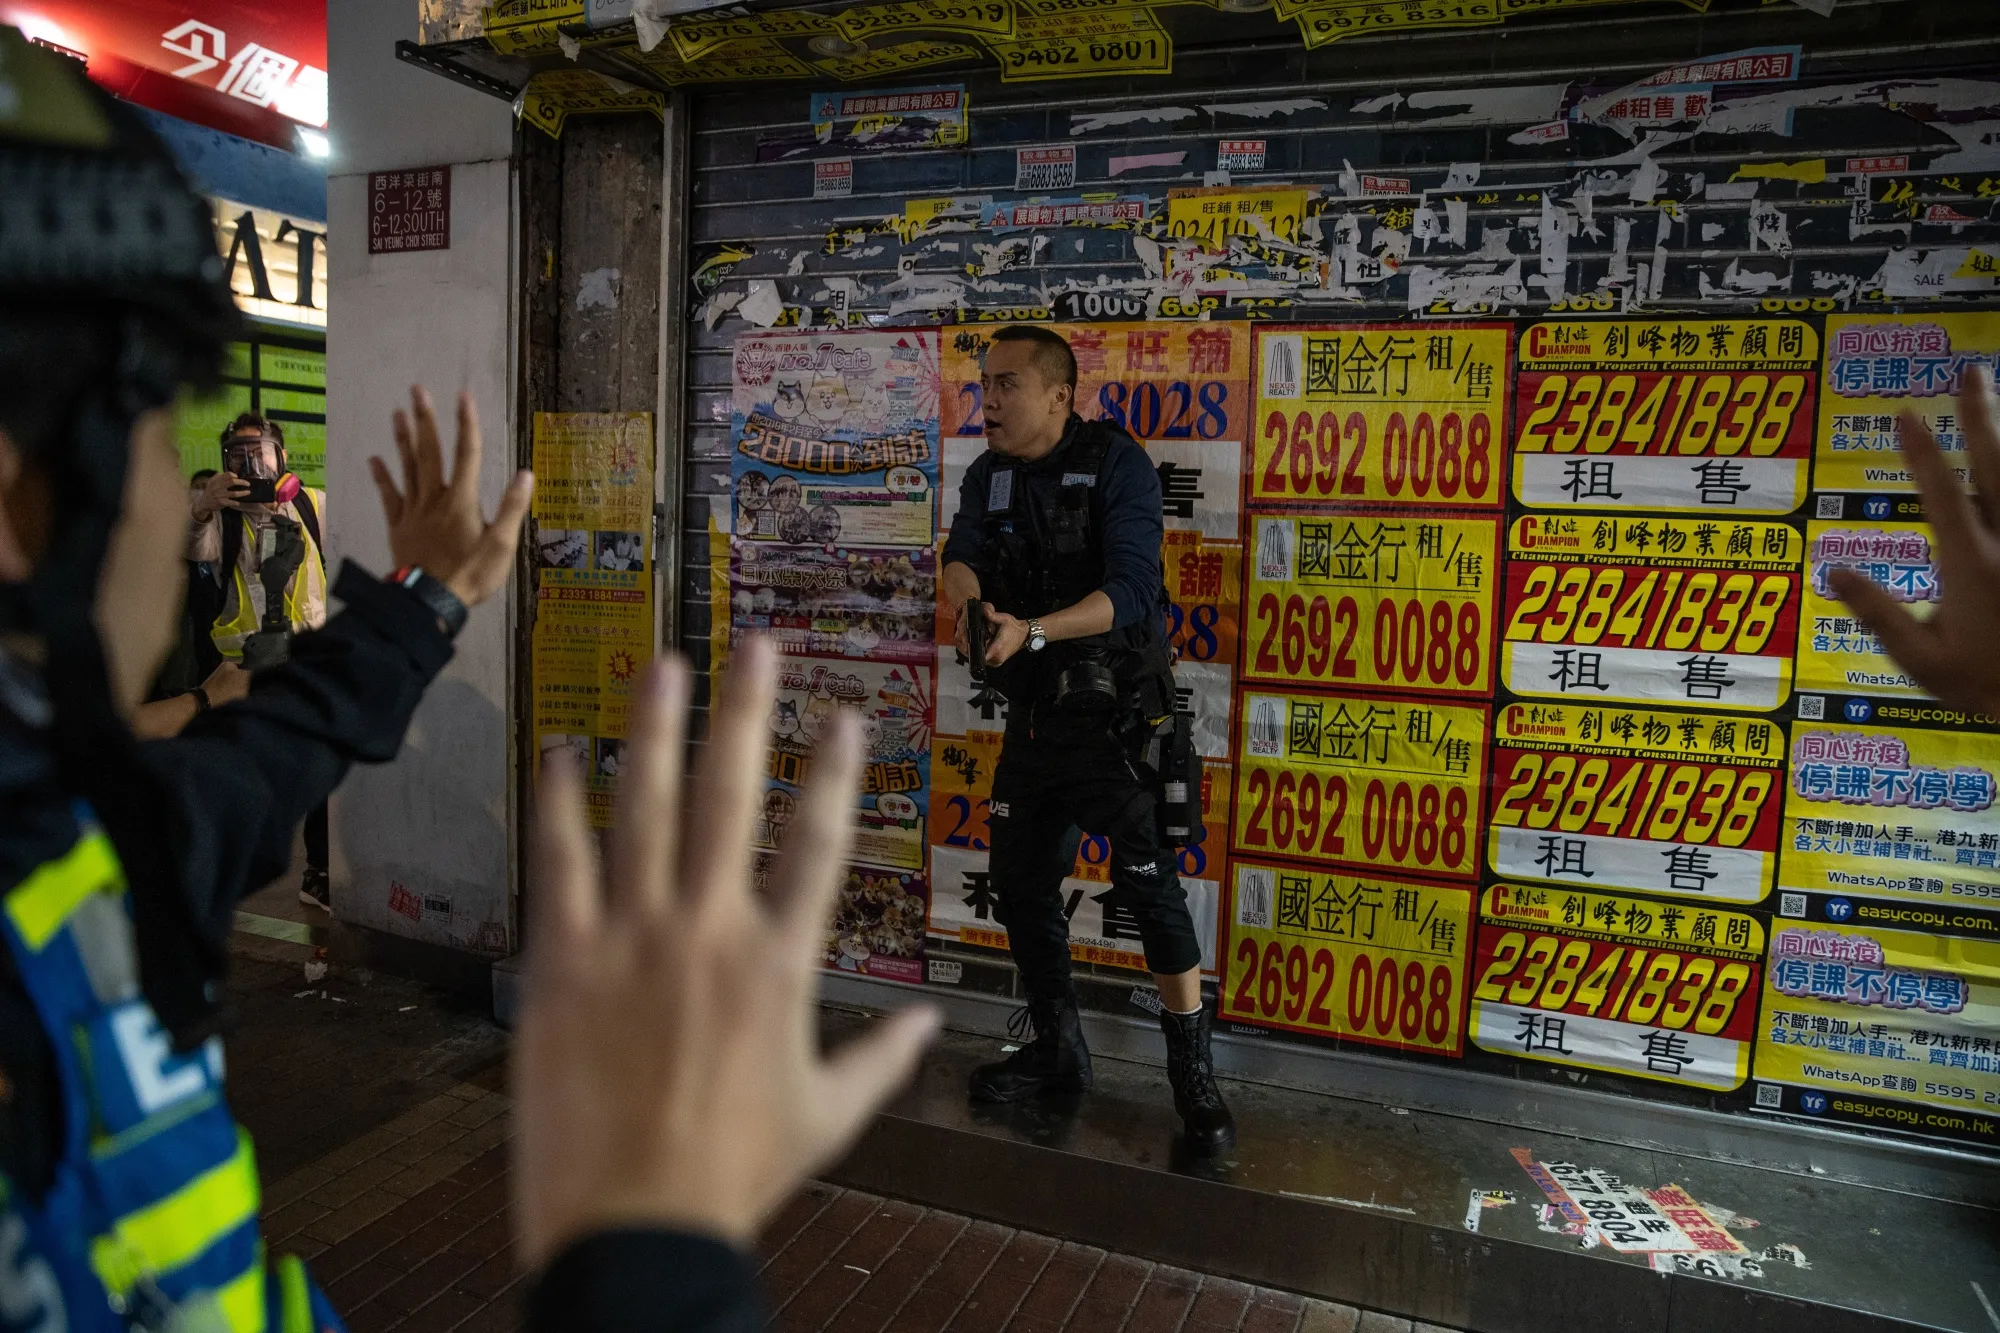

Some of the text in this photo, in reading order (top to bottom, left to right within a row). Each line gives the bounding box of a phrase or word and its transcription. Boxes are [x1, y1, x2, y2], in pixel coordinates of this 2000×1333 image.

[681, 23, 752, 43] 6976
[846, 11, 921, 31] 9283
[1313, 5, 1491, 33] 6976 8316
[837, 57, 897, 76] 5115
[375, 170, 443, 191] 西洋菜街南
[1030, 161, 1074, 189] 6883 9558
[403, 210, 445, 233] SOUTH
[1236, 200, 1274, 213] 租/售
[372, 232, 445, 250] SAI YEUNG CHOI STREET
[1913, 273, 1944, 286] SALE
[1529, 325, 1592, 359] CHAMPION
[1602, 324, 1803, 359] 創峰物業顧問
[1838, 330, 1944, 354] 同心抗疫
[831, 347, 872, 370] Cafe
[1305, 334, 1494, 399] 國金行 租/售
[1521, 360, 1813, 372] Champion Property Consultants Limited
[1269, 382, 1296, 390] NEXUS
[1269, 388, 1296, 397] REALTY
[1098, 381, 1229, 440] 8028
[1514, 374, 1807, 457] 23841838
[1262, 410, 1491, 499] 2692 0088
[1063, 475, 1095, 485] POLICE
[1560, 458, 1751, 505] 租 售
[1868, 501, 1888, 515] YF
[1519, 516, 1581, 549] CHAMPION
[1591, 518, 1789, 560] 創峰物業顧問
[1820, 535, 1925, 560] 同心抗疫
[1261, 564, 1288, 572] NEXUS
[1298, 521, 1484, 589] 國金行 租/售
[1510, 551, 1797, 572] Champion Property Consultants Limited
[1261, 571, 1288, 579] REALTY
[562, 588, 612, 601] 2332 1884
[1504, 565, 1793, 654] 23841838
[1254, 592, 1481, 686] 2692 0088
[825, 672, 865, 695] Cafe
[1548, 649, 1736, 700] 租 售
[1505, 704, 1567, 738] CHAMPION
[1848, 703, 1869, 718] YF
[1252, 740, 1279, 749] NEXUS
[1288, 699, 1471, 774] 國金行 租/售
[1577, 709, 1771, 757] 創峰物業顧問
[1252, 747, 1279, 755] REALTY
[1497, 738, 1780, 769] Champion Property Consultants Limited
[1802, 736, 1903, 765] 同心抗疫
[1799, 762, 1990, 807] 停課不停學
[1491, 753, 1773, 848] 23841838
[1243, 767, 1468, 869] 2692 0088
[1534, 835, 1719, 892] 租 售
[1954, 848, 2000, 869] 齊齊
[1827, 871, 1944, 894] WhatsApp查詢
[1241, 910, 1268, 920] NEXUS
[1276, 873, 1457, 953] 國金行 租/售
[1491, 885, 1550, 920] CHAMPION
[1829, 902, 1849, 917] YF
[1241, 917, 1268, 926] REALTY
[1560, 894, 1751, 951] 創峰物業顧問
[1482, 917, 1758, 962] Champion Property Consultants Limited
[1780, 933, 1878, 965] 同心抗疫
[1232, 937, 1453, 1044] 2692 0088
[1472, 931, 1751, 1036] 23841838
[1775, 957, 1963, 1009] 停課不停學
[1514, 1011, 1695, 1076] 租 售
[1802, 1064, 1918, 1092] WhatsApp查詢
[1925, 1082, 1976, 1101] 5595
[1803, 1094, 1996, 1135] YF easycopy.com.hk
[1578, 1198, 1650, 1245] 8804
